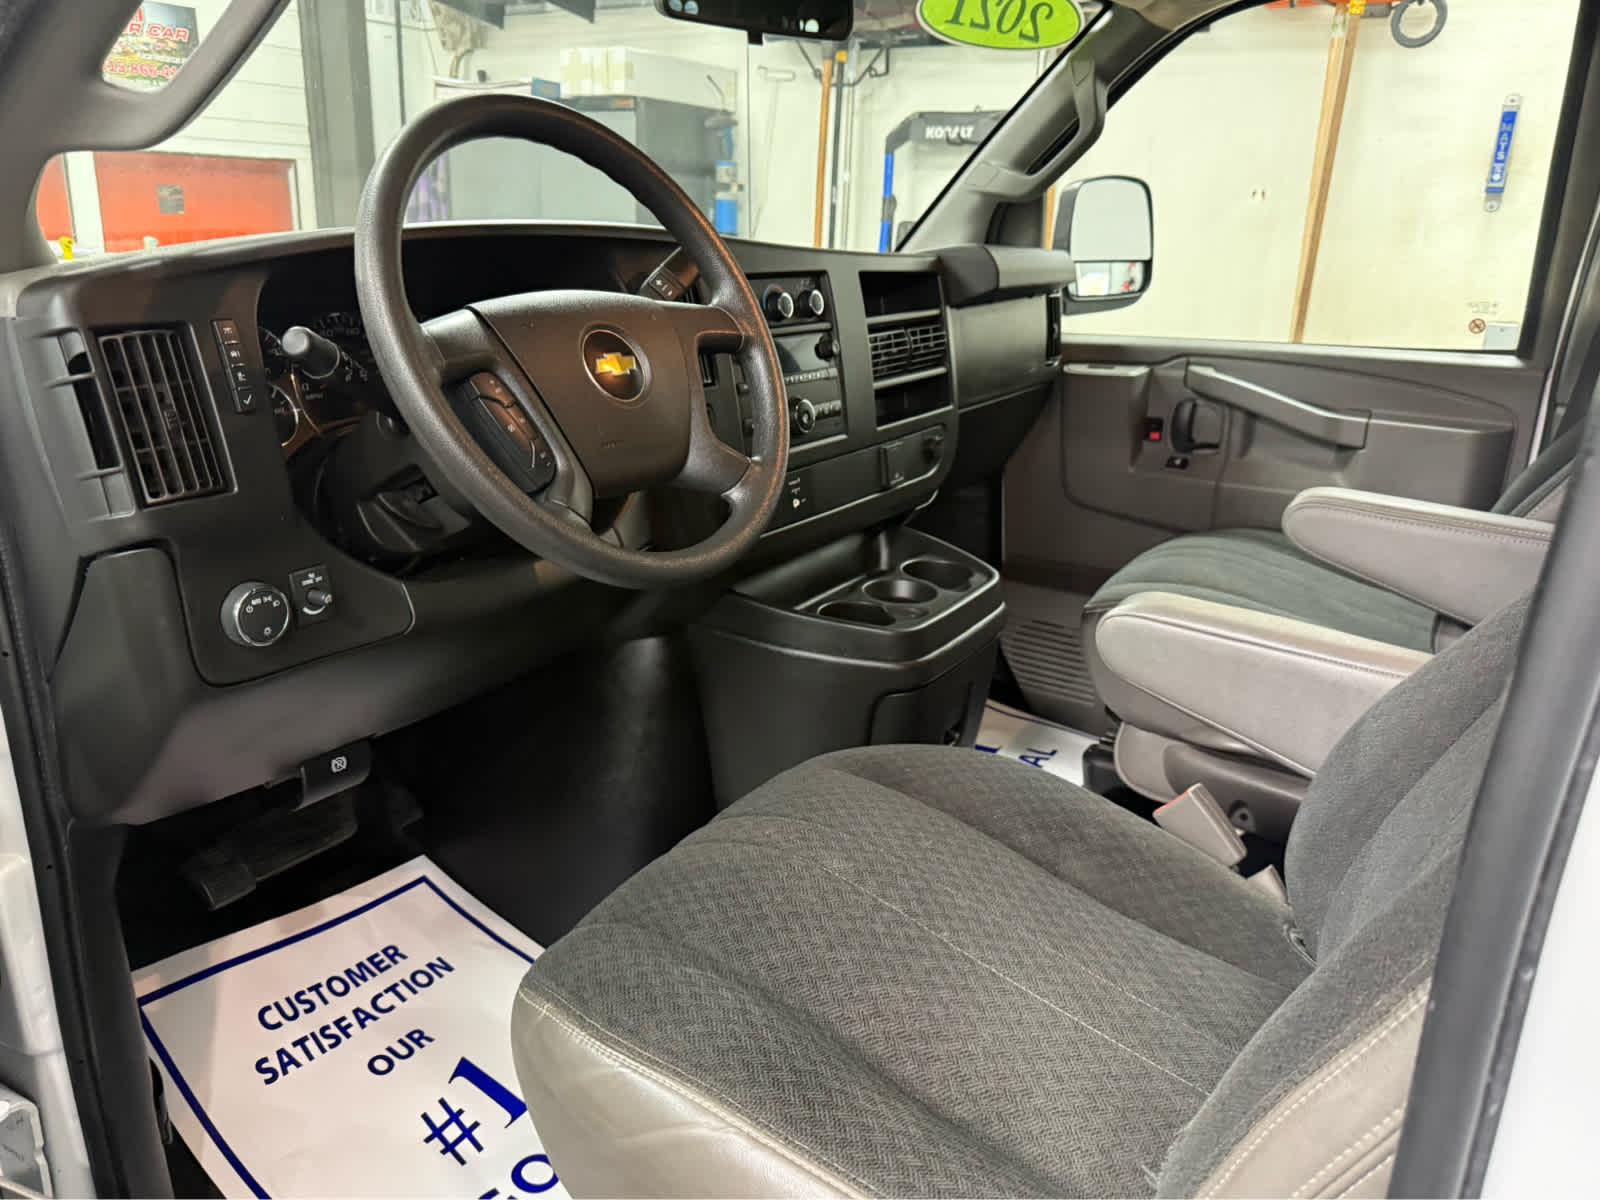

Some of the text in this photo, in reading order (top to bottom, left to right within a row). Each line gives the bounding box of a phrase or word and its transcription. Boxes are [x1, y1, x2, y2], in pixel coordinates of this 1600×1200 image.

[149, 25, 189, 41] CAR
[255, 956, 454, 1085] SATISFACTION
[257, 944, 408, 1031] CUSTOMER
[367, 1028, 435, 1076] OUR
[421, 1057, 527, 1166] #1
